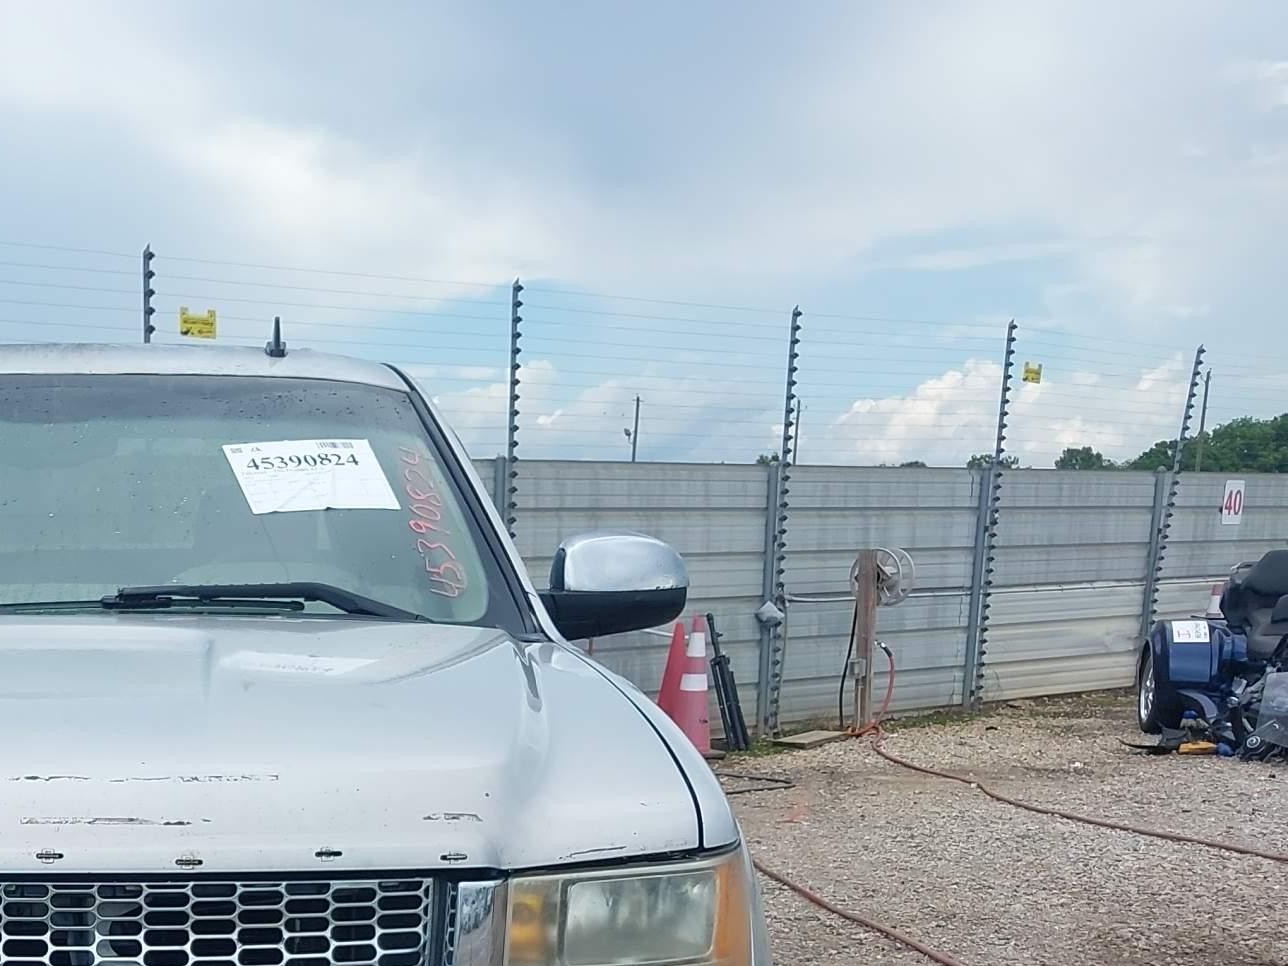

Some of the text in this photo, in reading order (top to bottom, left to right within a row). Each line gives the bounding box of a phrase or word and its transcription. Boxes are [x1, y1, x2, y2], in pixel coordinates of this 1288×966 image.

[246, 453, 360, 471] 45390824
[1224, 489, 1242, 516] 40
[399, 446, 465, 597] 45390824
